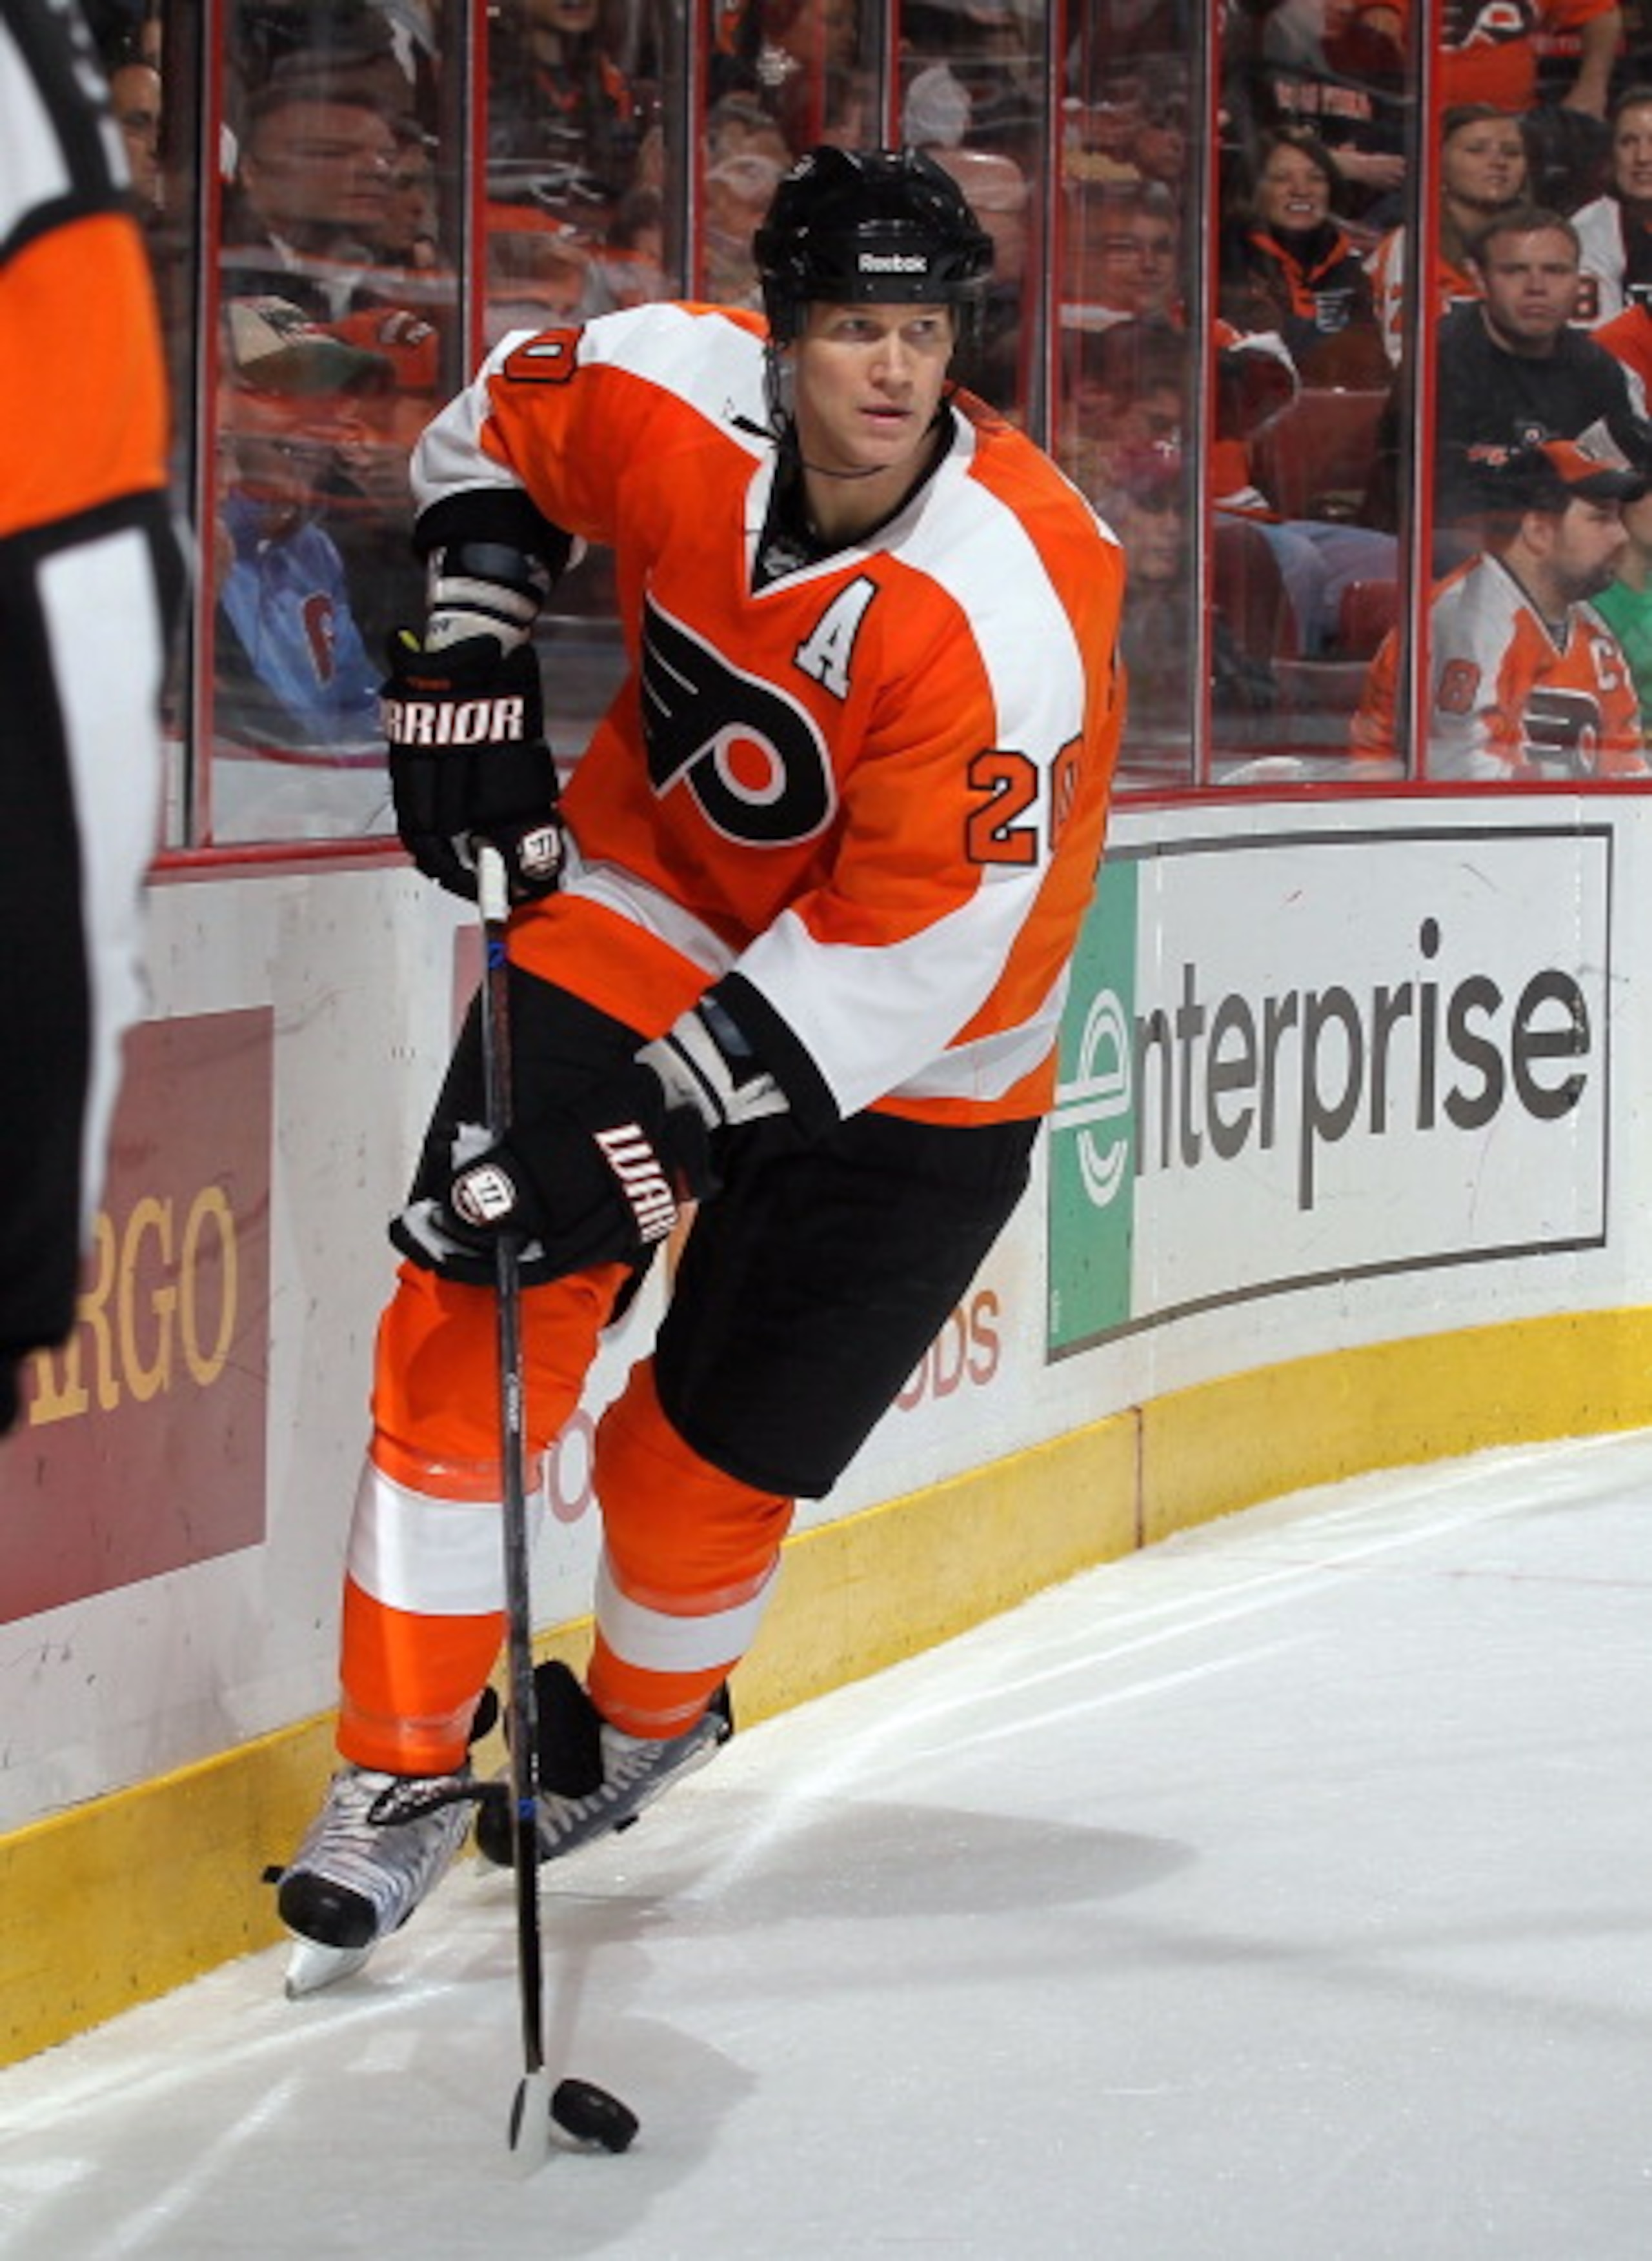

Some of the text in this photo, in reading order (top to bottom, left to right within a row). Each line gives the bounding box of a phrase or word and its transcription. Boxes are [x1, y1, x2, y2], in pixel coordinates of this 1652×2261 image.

[858, 253, 927, 272] Reebok
[792, 574, 879, 700] A
[1590, 636, 1618, 690] C
[1438, 659, 1482, 715] 8
[1049, 917, 1591, 1211] enterprise
[29, 1185, 238, 1426] RGO
